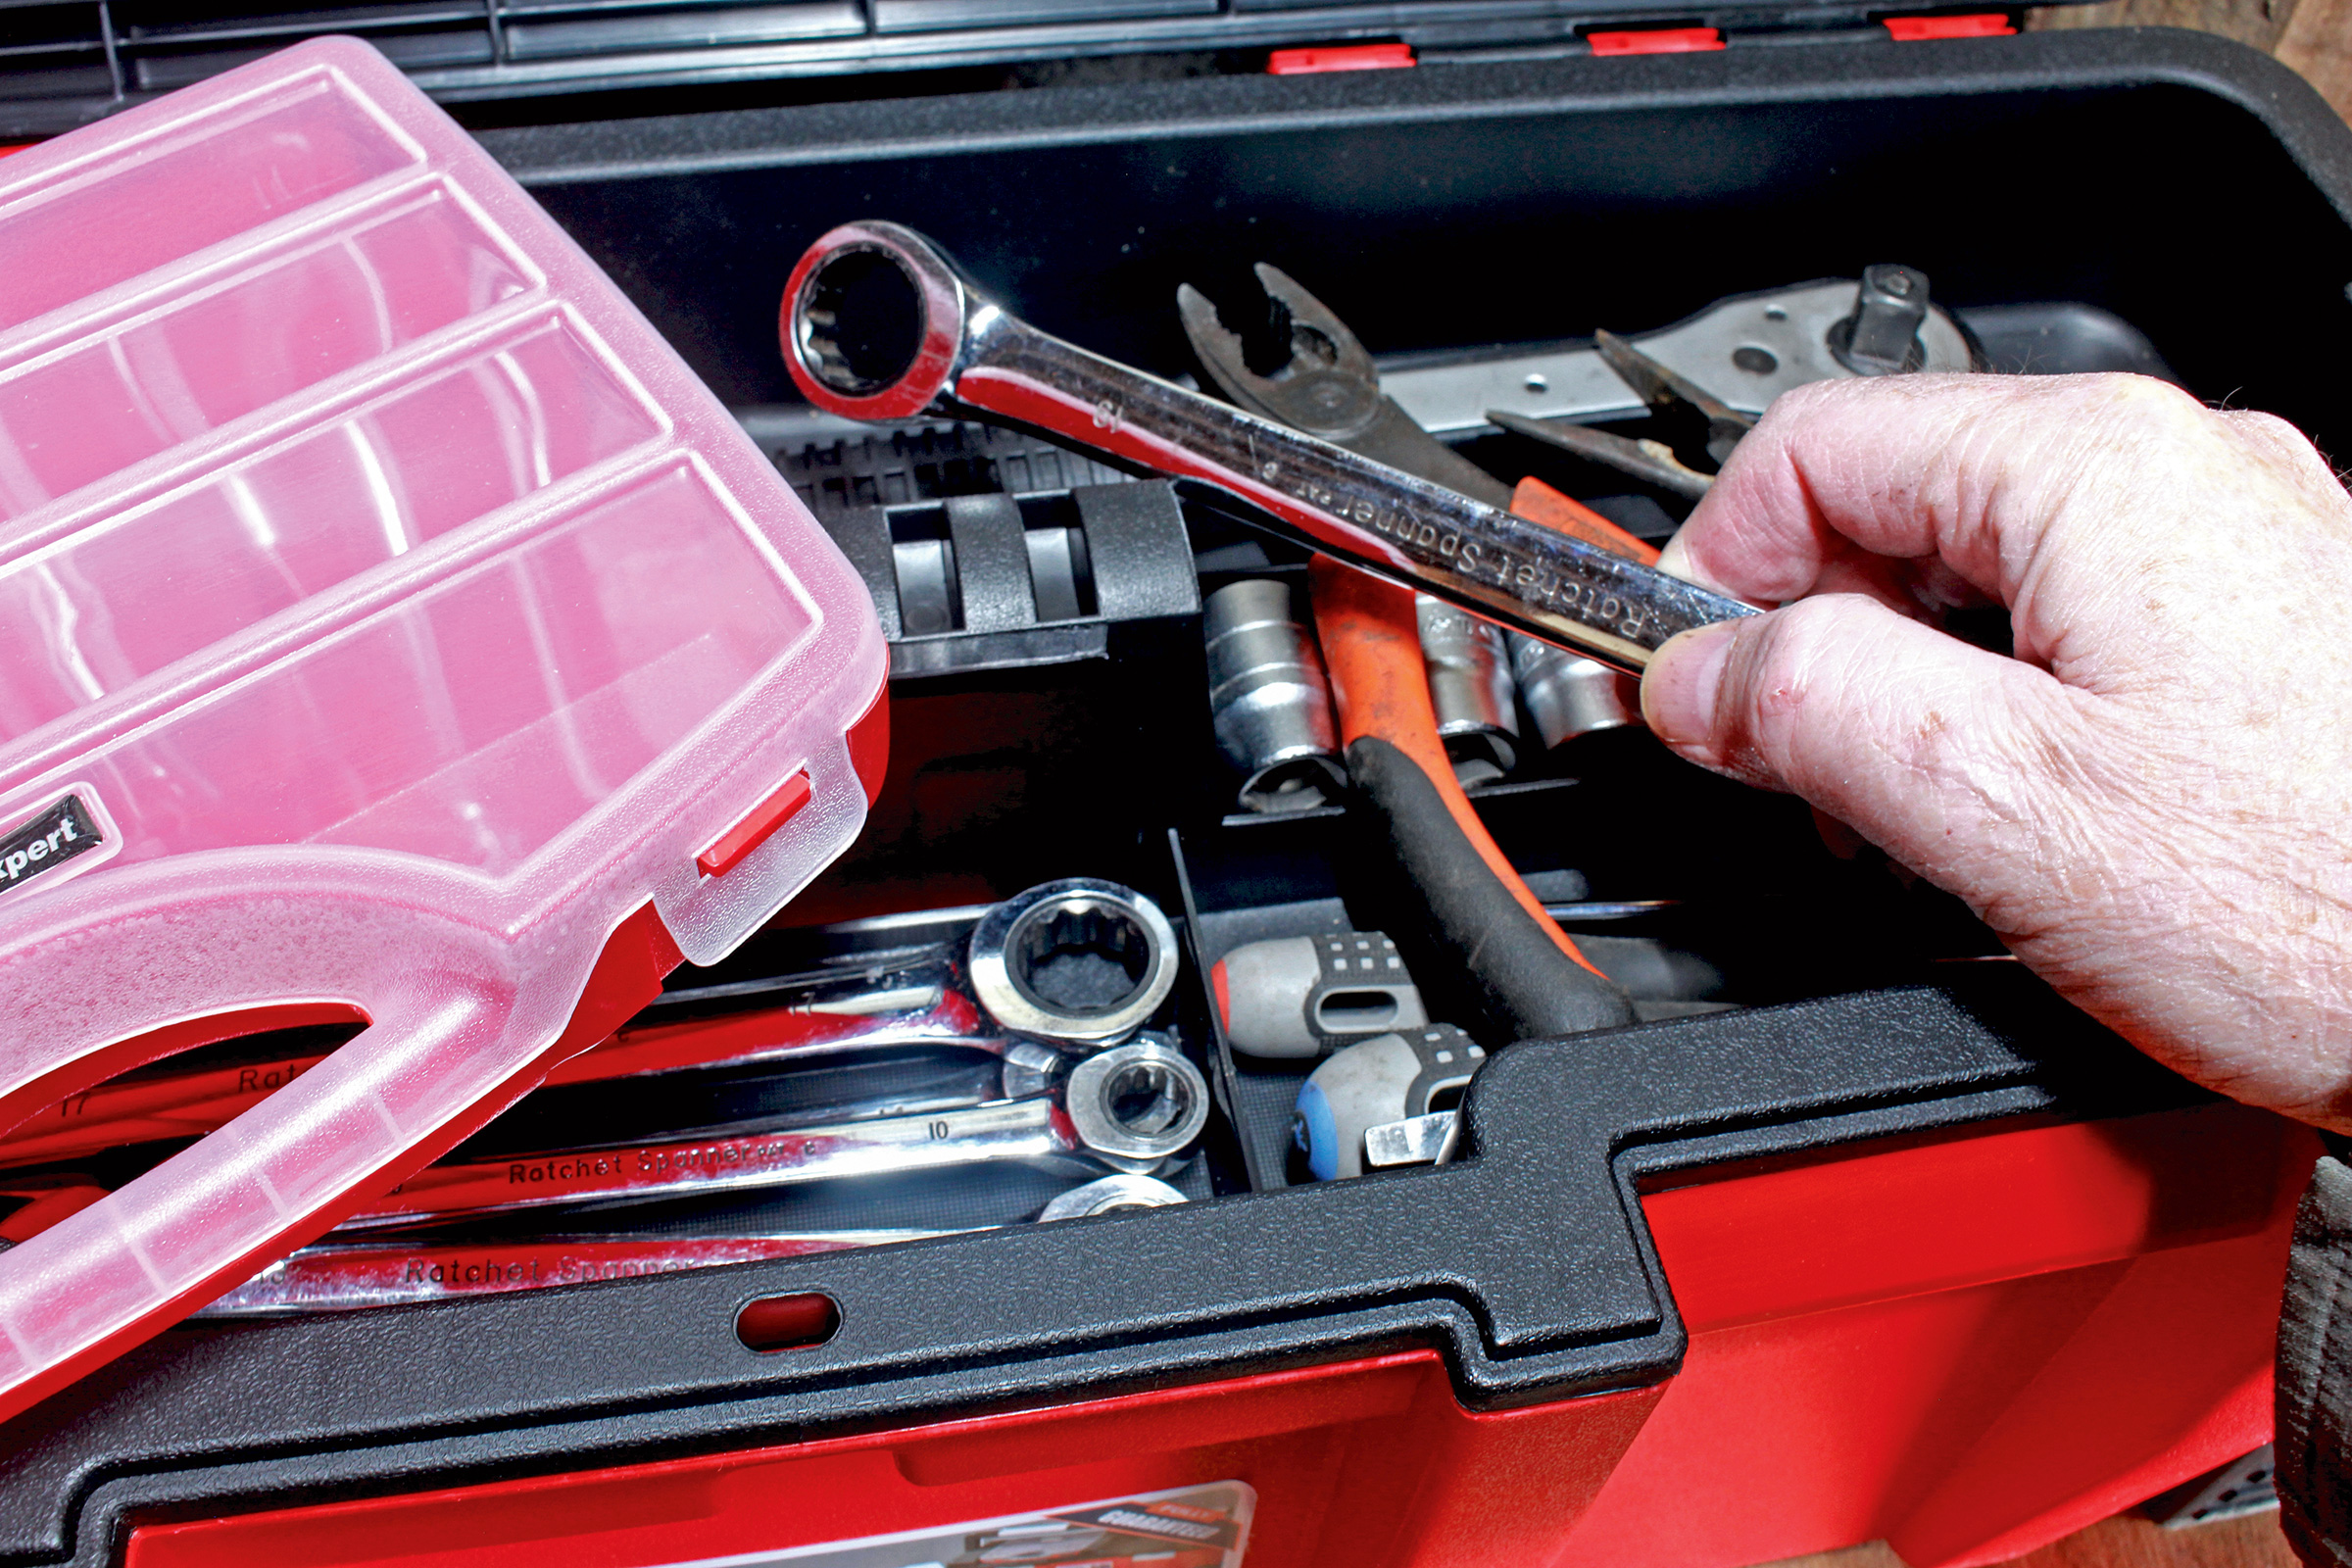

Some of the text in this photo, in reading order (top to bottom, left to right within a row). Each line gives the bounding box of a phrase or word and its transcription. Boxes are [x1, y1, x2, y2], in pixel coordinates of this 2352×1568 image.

[1336, 495, 1481, 573] Spanner
[1495, 556, 1647, 638] Ratchet
[929, 1121, 948, 1141] 10
[509, 1154, 621, 1184] Ratchet
[638, 1144, 751, 1174] Spanner
[406, 1255, 539, 1283] Ratchet
